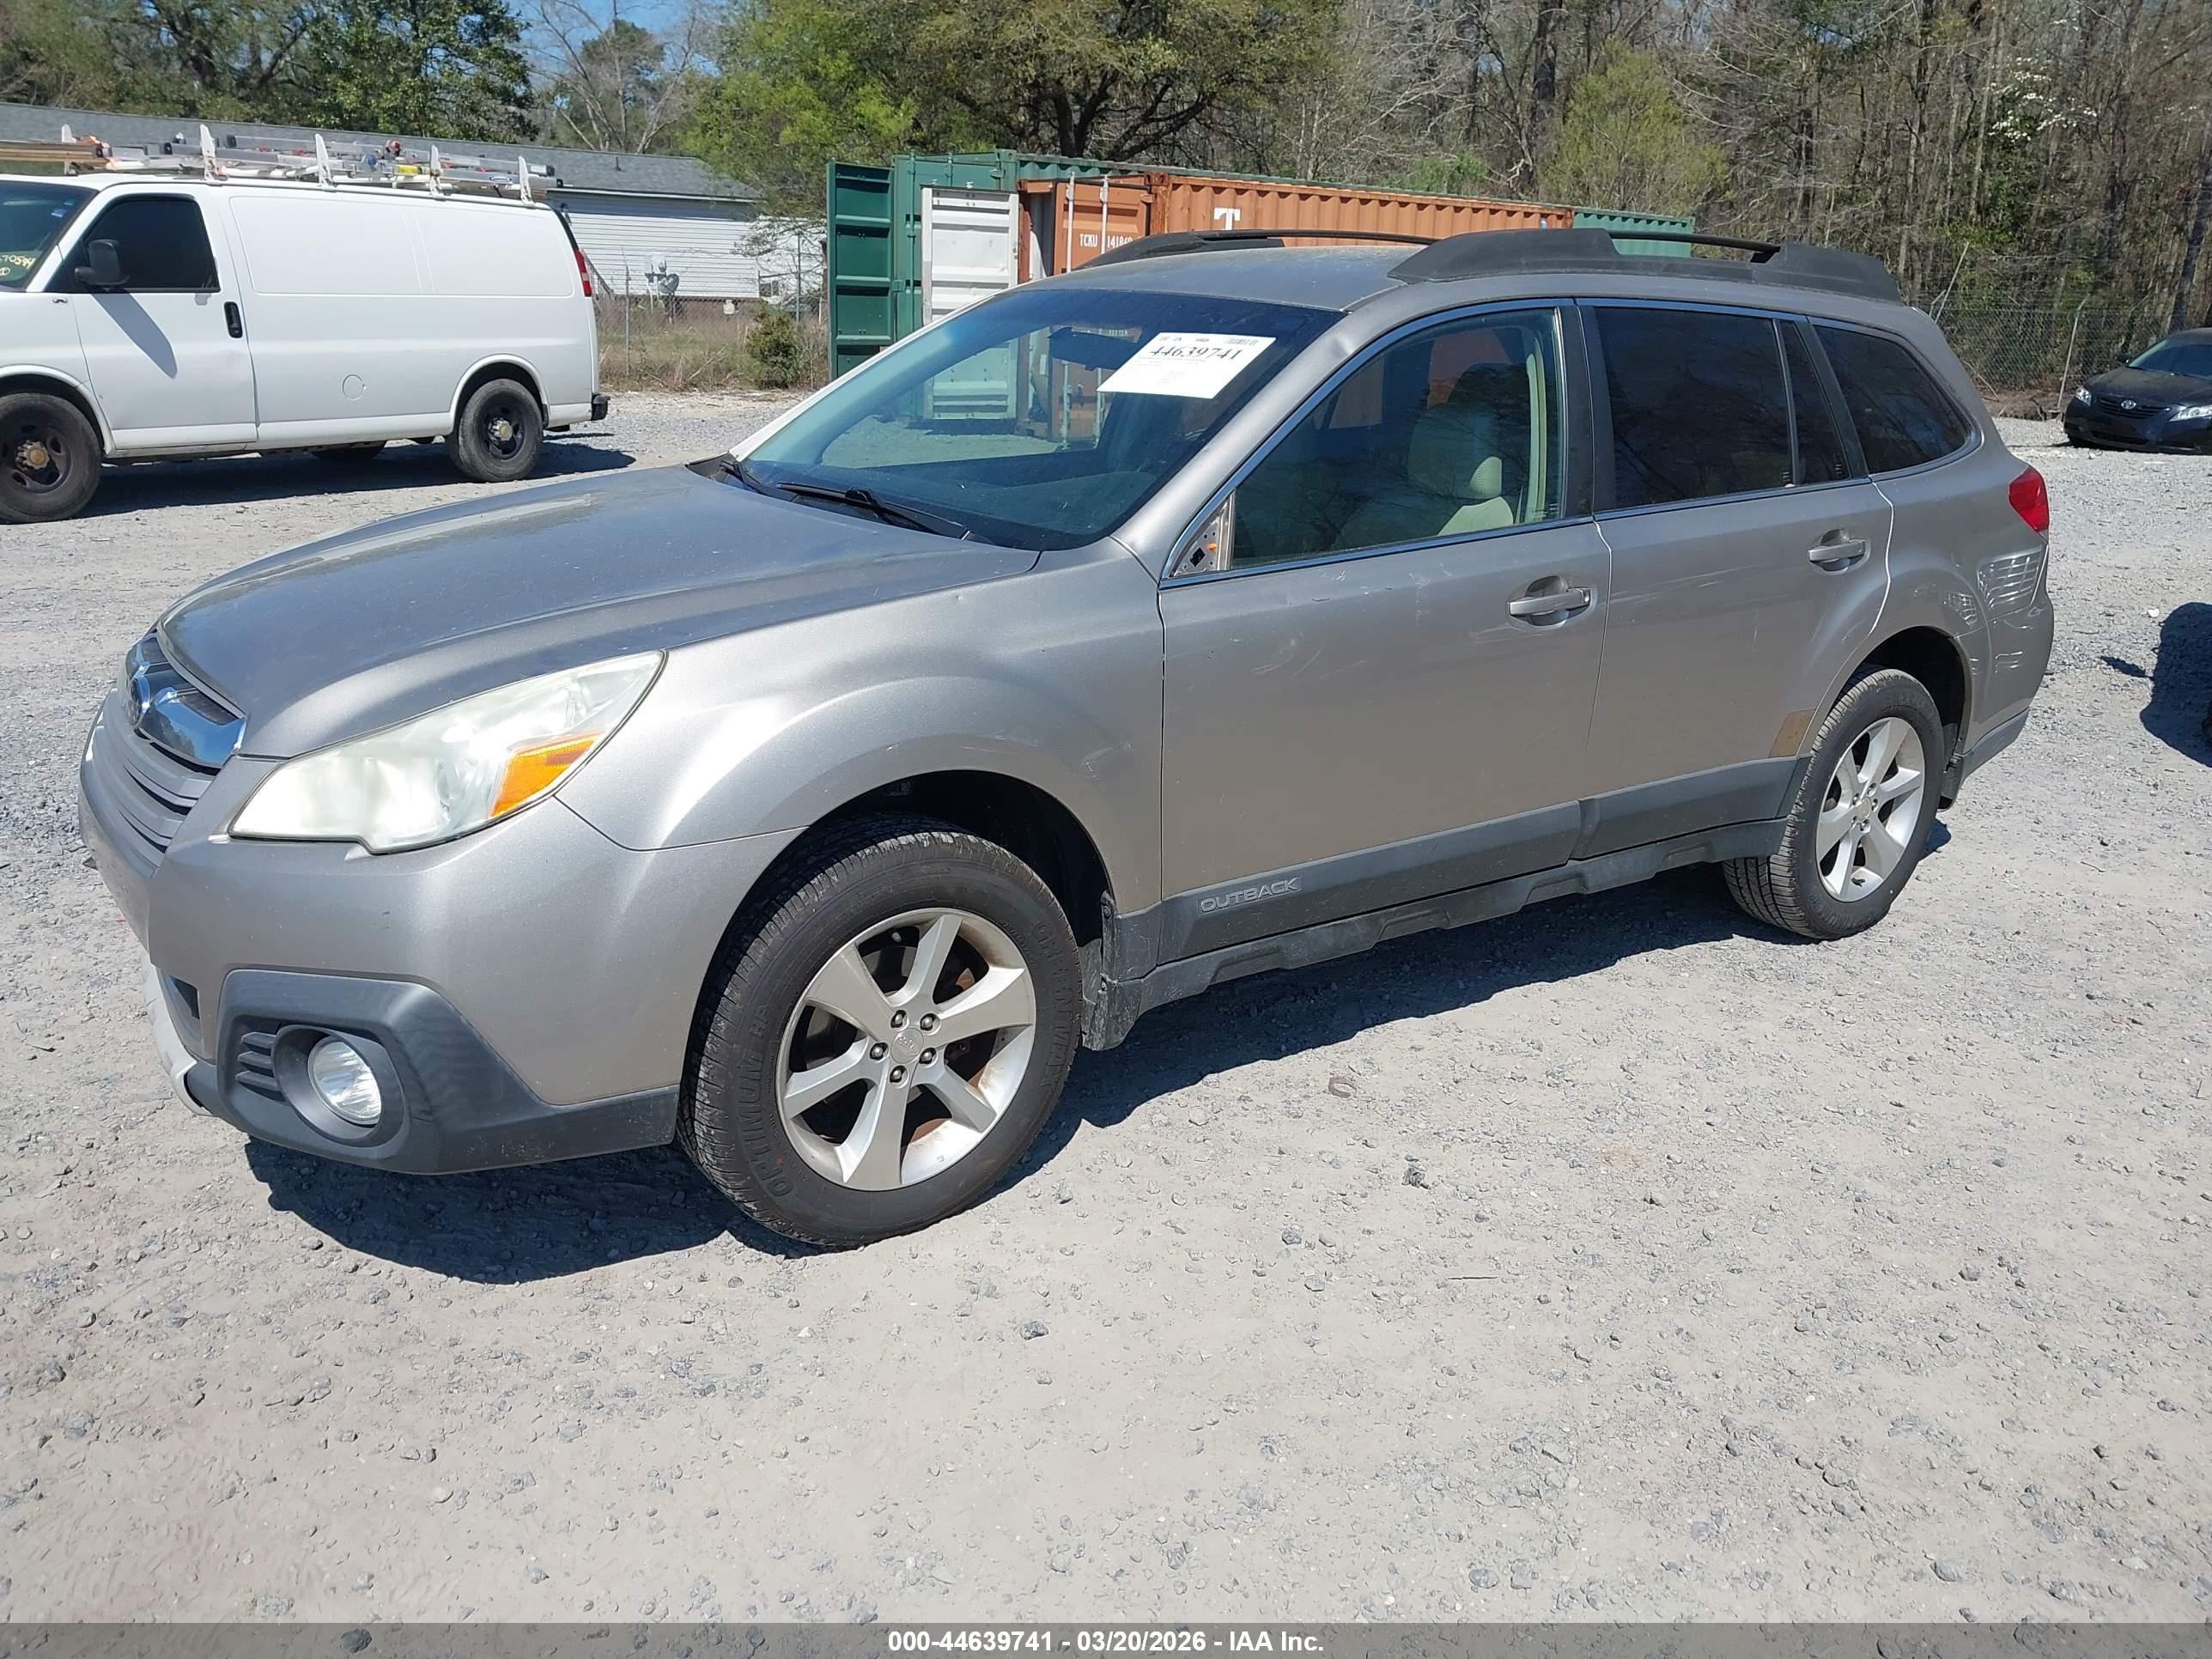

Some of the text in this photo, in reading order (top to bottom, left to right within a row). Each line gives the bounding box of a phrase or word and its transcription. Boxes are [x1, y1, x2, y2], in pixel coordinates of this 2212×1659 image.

[1079, 234, 1098, 247] TCKU
[1149, 345, 1243, 360] 44639741
[1200, 877, 1299, 912] OUTBACK
